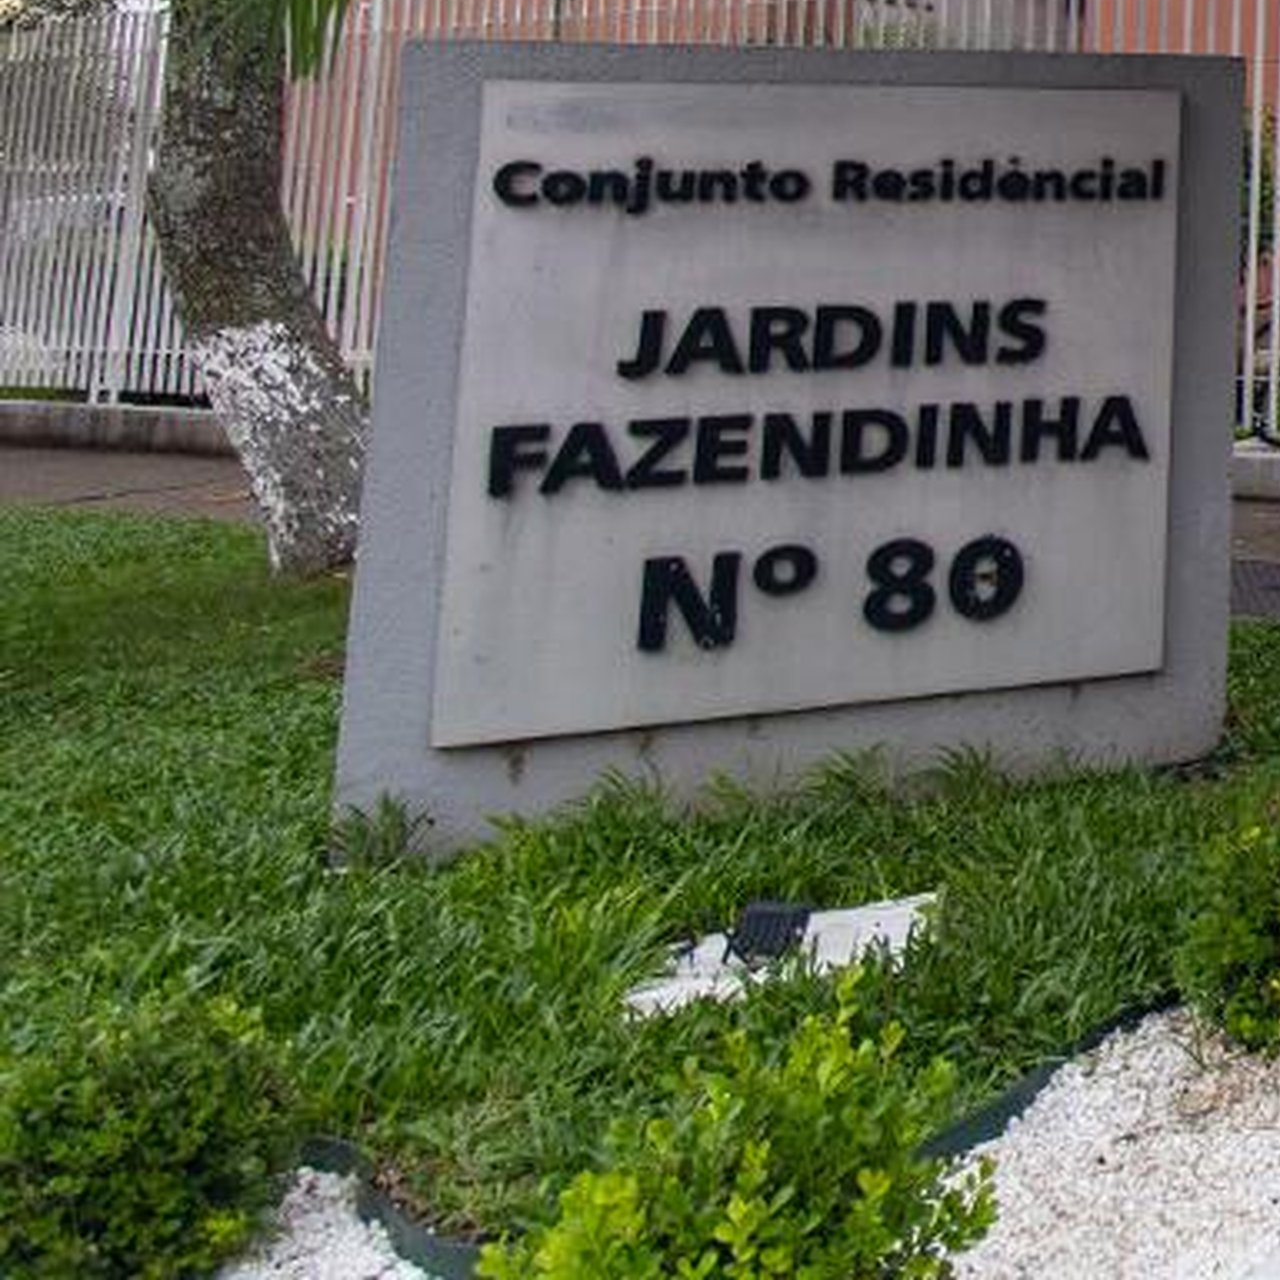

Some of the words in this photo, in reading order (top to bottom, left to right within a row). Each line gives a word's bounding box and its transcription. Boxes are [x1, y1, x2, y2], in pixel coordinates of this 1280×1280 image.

[493, 158, 811, 215] Conjunto
[617, 297, 1047, 379] JARDINS
[488, 395, 1150, 498] FAZENDINHA
[862, 534, 1025, 634] 80
